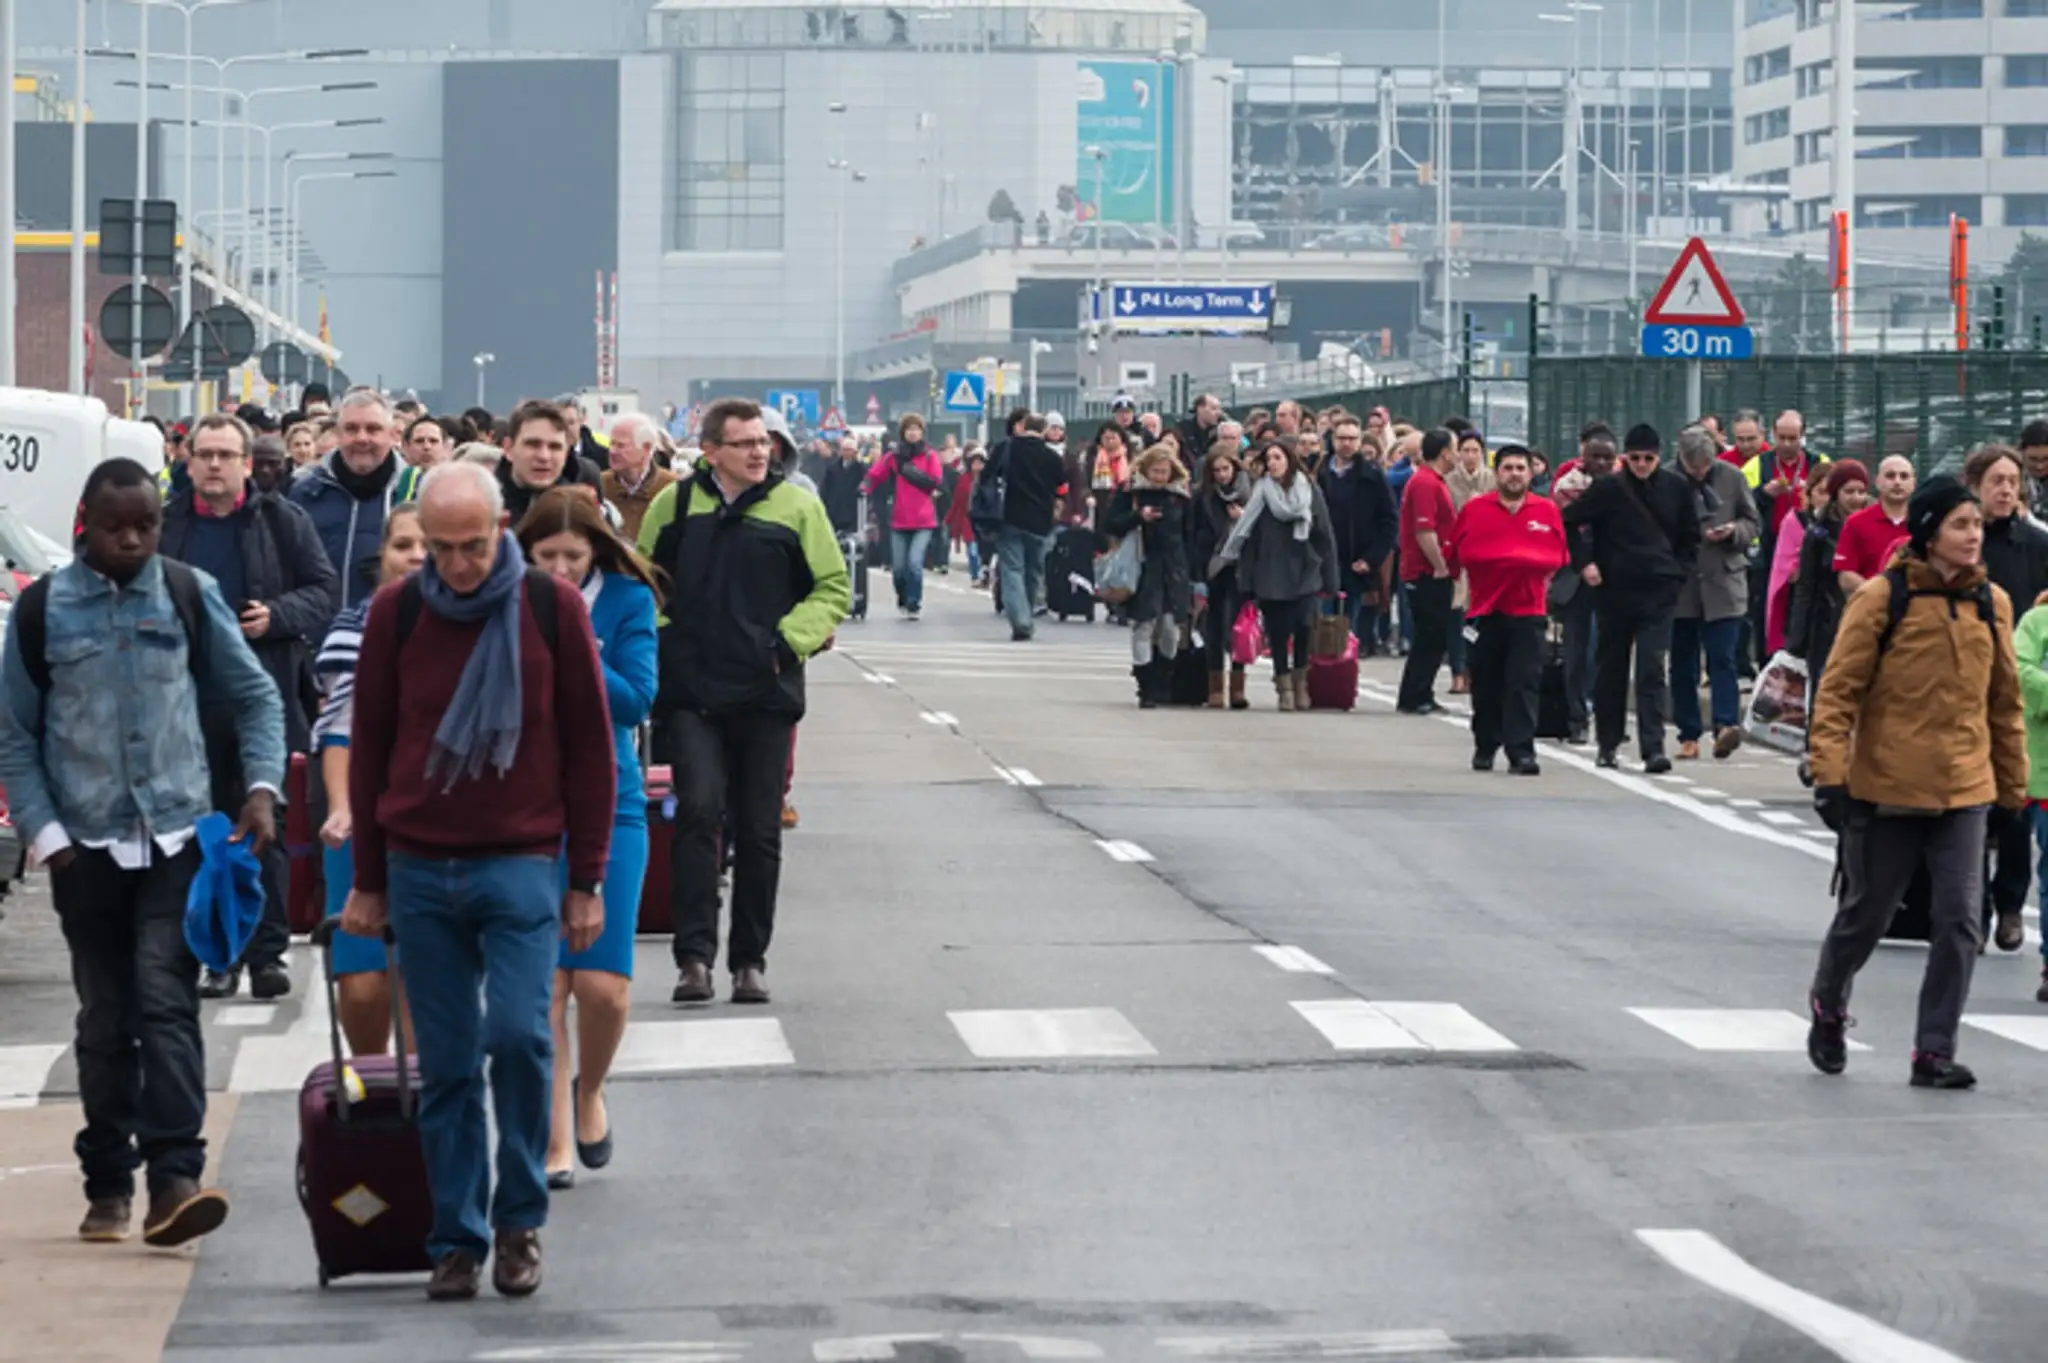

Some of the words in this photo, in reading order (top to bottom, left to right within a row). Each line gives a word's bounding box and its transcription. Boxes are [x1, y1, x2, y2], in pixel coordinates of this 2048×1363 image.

[1141, 292, 1161, 307] P4
[1164, 292, 1204, 311] Long
[1206, 292, 1244, 307] Term
[1662, 328, 1699, 355] 30
[1705, 336, 1732, 355] m
[781, 392, 798, 421] P
[0, 433, 39, 472] 30
